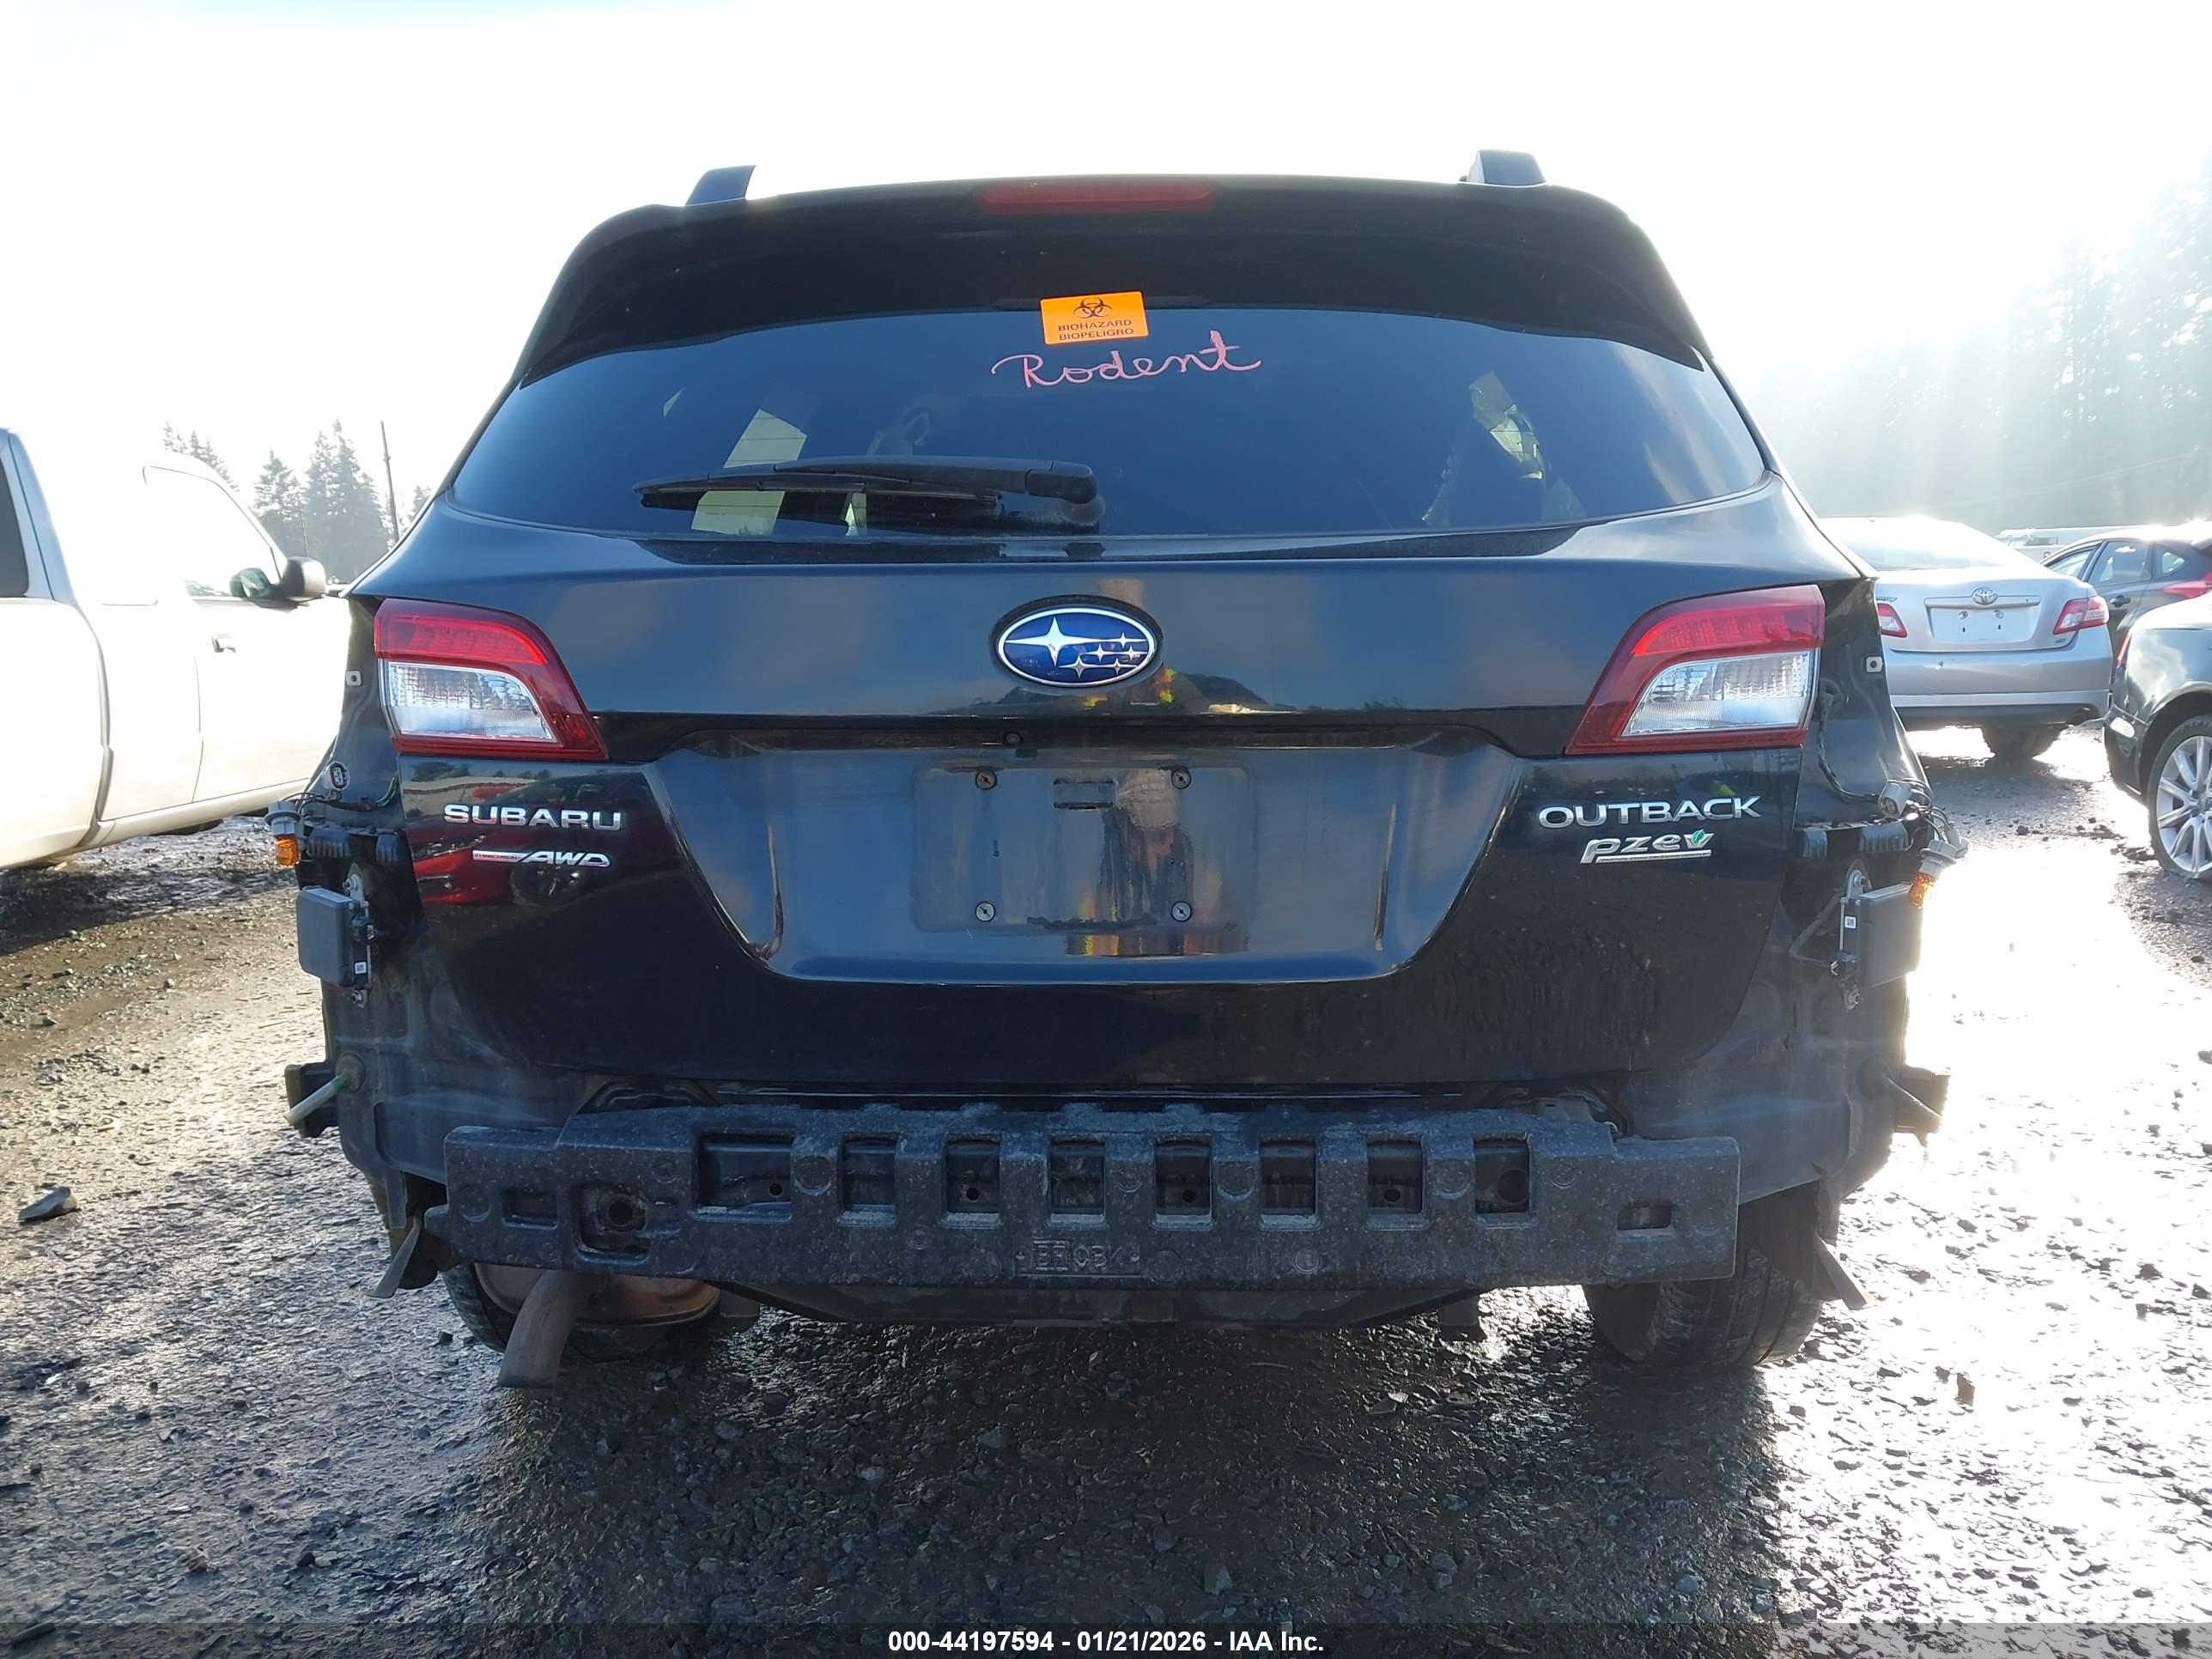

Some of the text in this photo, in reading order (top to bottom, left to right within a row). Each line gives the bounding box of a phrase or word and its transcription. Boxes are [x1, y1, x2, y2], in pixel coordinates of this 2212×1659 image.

[1058, 319, 1132, 331] BIOHAZARD
[1059, 328, 1134, 341] BIOPELIGRO
[991, 330, 1261, 387] Rodent
[444, 805, 621, 830] SUBARU
[1538, 795, 1761, 828] OUTBACK
[521, 851, 611, 867] AWD
